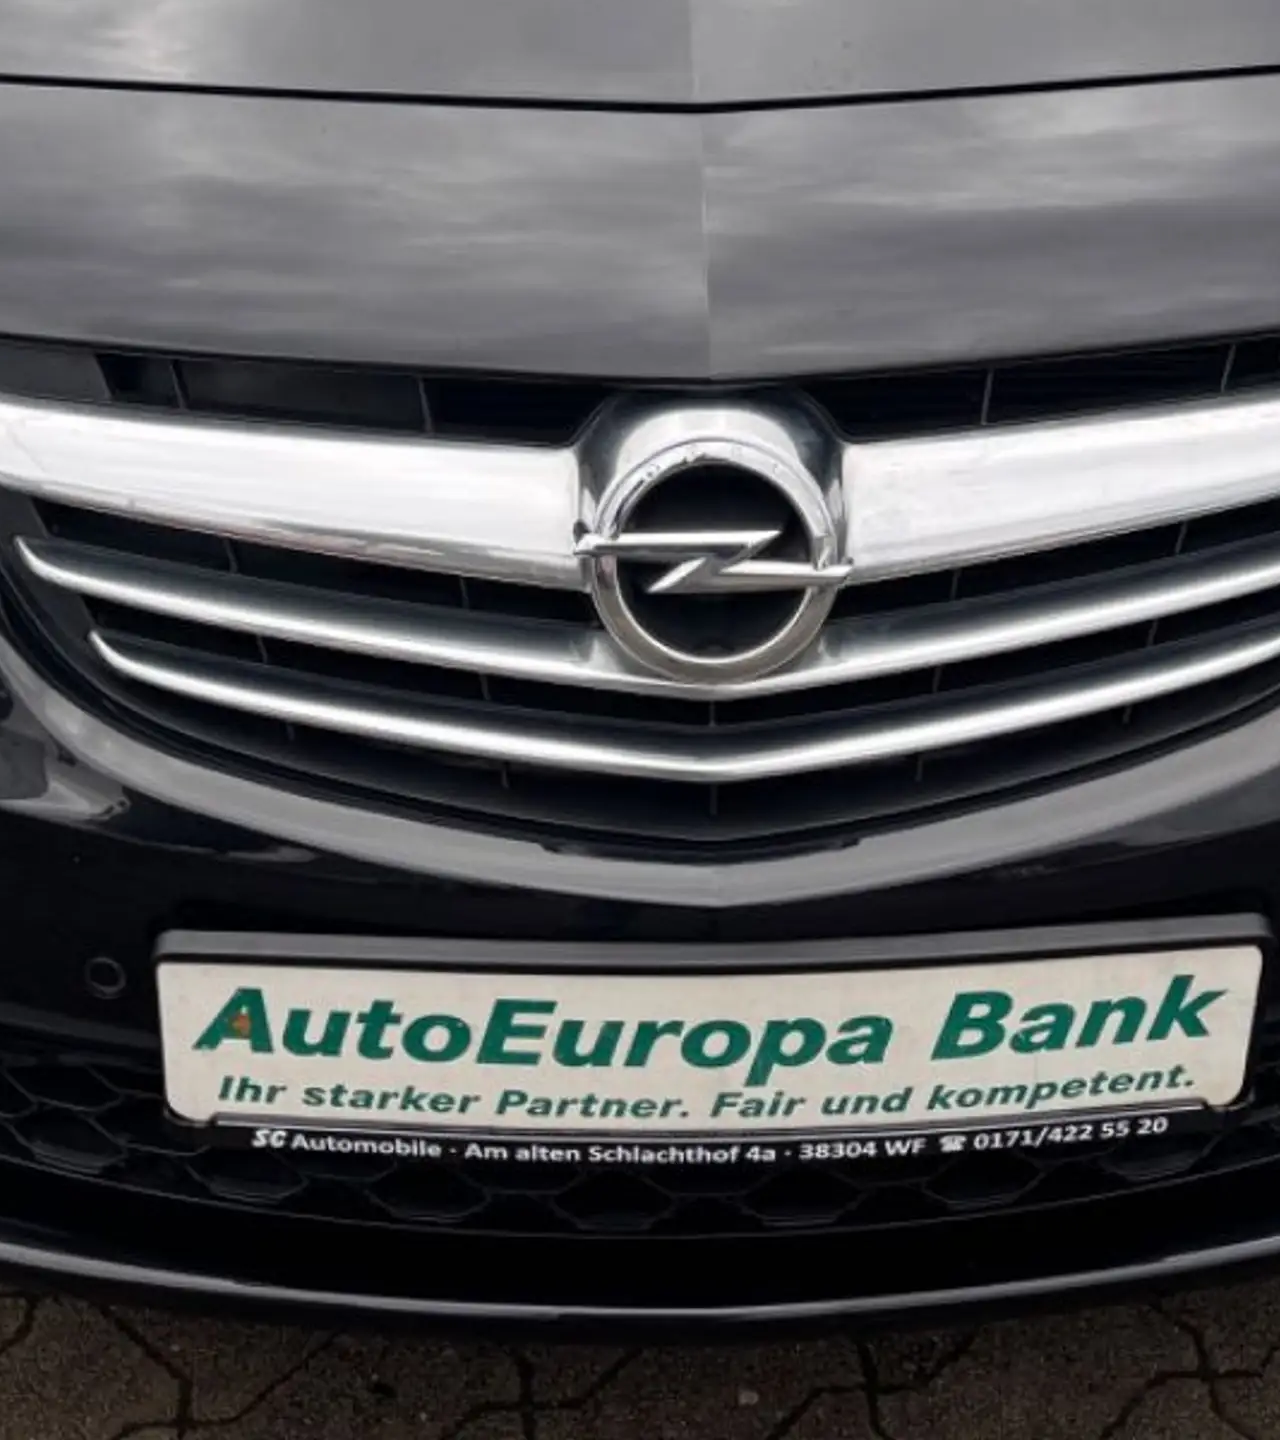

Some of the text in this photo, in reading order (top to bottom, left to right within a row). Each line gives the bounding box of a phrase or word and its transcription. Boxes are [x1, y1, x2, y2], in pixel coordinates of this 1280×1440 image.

[192, 973, 1229, 1087] AutoEuropa Bank
[218, 1062, 1196, 1120] Ihr starker Partner. Fair und kompetent.
[251, 1128, 287, 1150] SC
[290, 1133, 442, 1158] Automobile
[464, 1143, 508, 1161] Am
[516, 1145, 582, 1162] alten
[587, 1144, 739, 1165] Schlachthof
[745, 1146, 777, 1163] 4a
[798, 1141, 878, 1162] 38304
[883, 1138, 928, 1156] WF
[973, 1124, 1095, 1151] 0171/422
[1100, 1121, 1131, 1140] 55
[1136, 1116, 1169, 1136] 20
